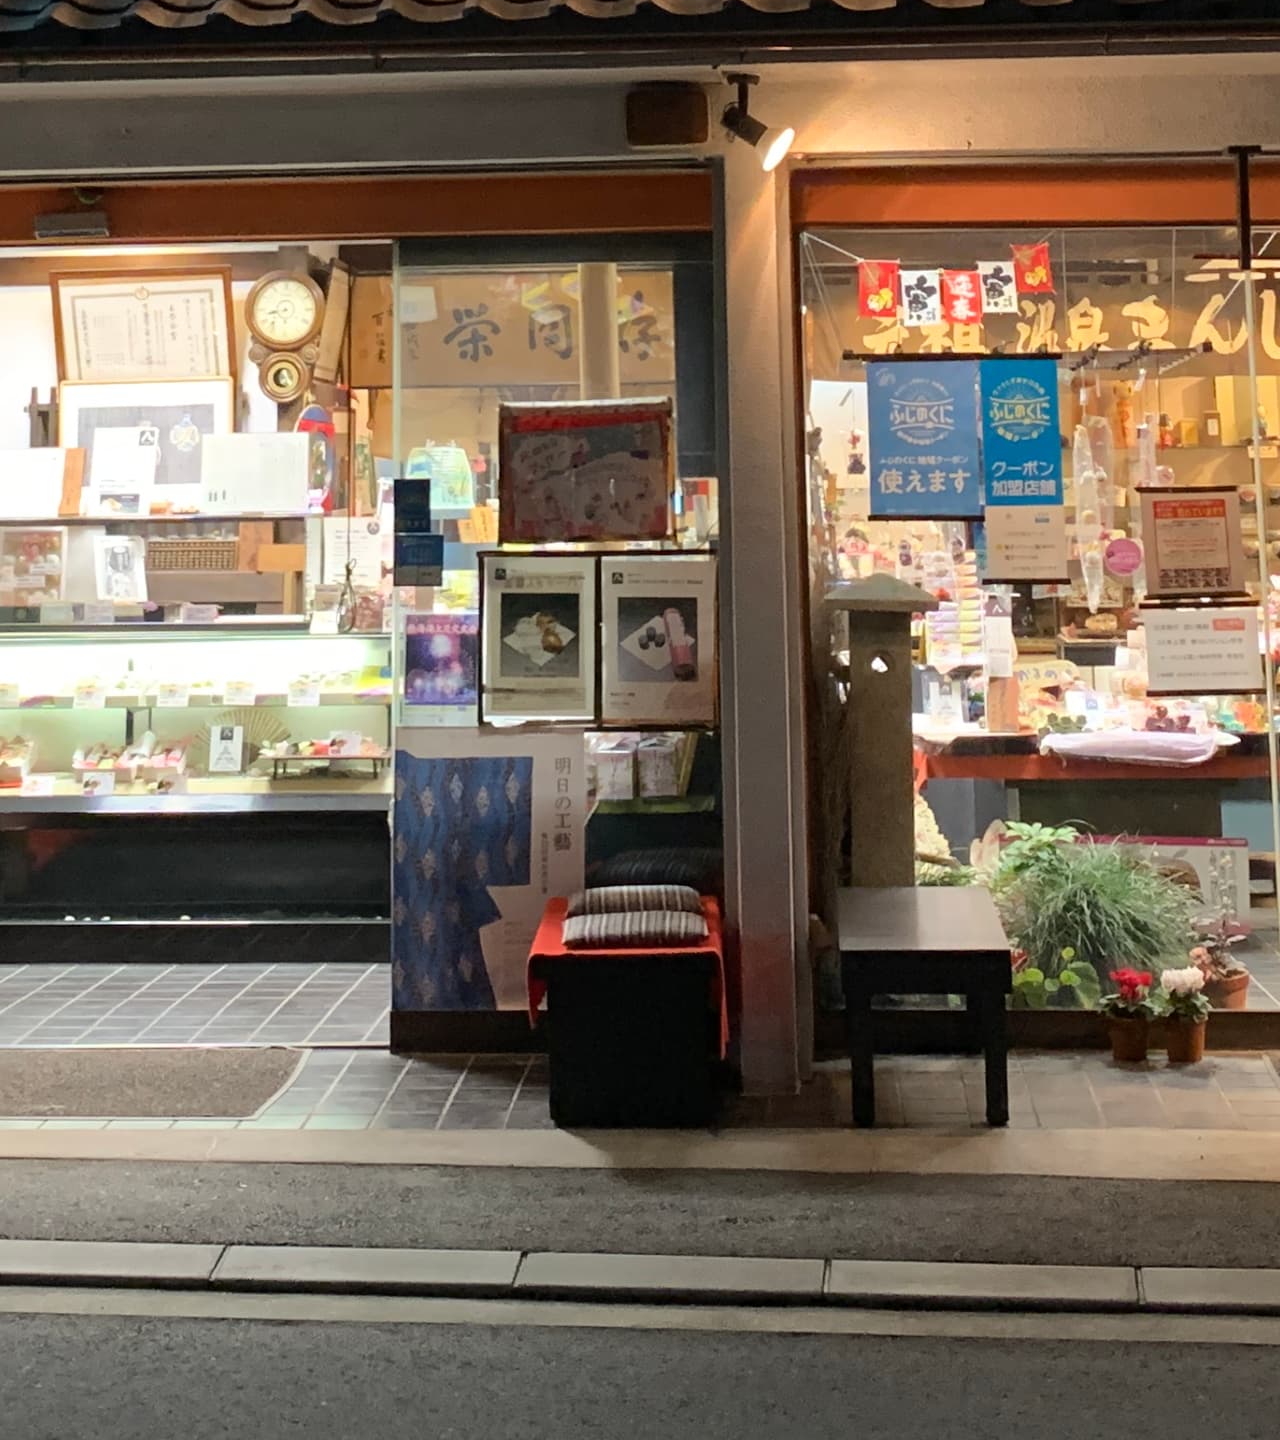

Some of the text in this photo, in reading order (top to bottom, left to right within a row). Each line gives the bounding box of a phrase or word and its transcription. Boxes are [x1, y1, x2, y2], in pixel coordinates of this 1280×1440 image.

[949, 273, 977, 321] 迎春
[890, 404, 955, 424] ふじのくに
[989, 402, 1051, 422] ふじのくに
[992, 461, 1055, 478] クーポン
[877, 468, 971, 494] 使えます
[992, 479, 1057, 497] 加盟店舗
